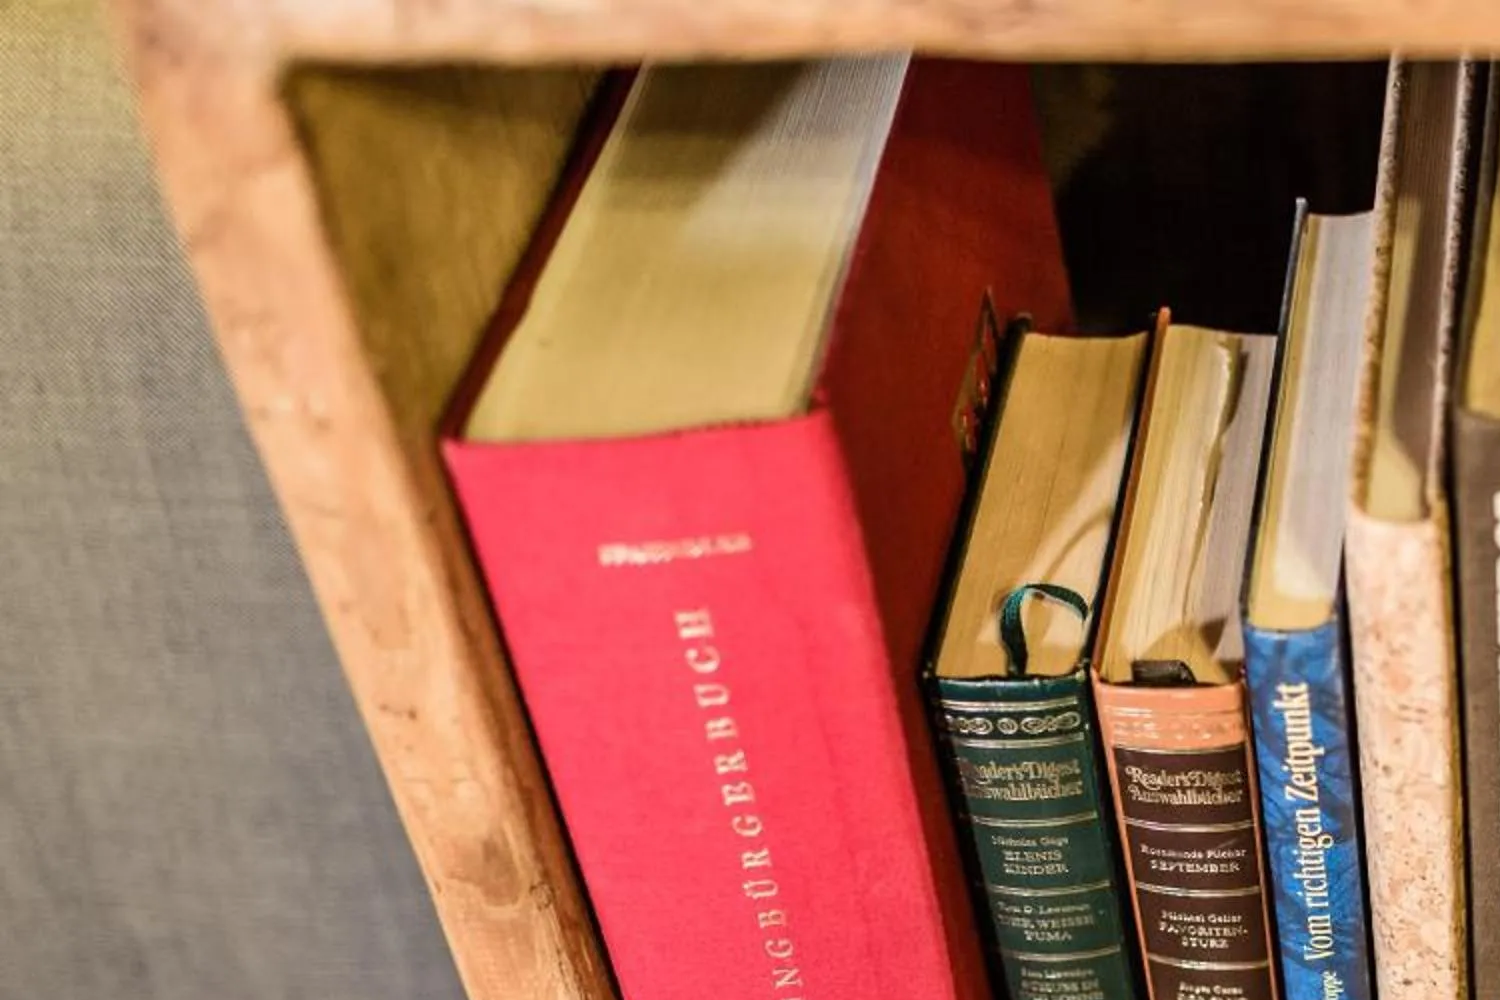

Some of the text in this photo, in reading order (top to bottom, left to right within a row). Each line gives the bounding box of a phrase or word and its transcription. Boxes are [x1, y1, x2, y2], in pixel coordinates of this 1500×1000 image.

[1273, 681, 1336, 962] Vom richtigen Zeitpunkt
